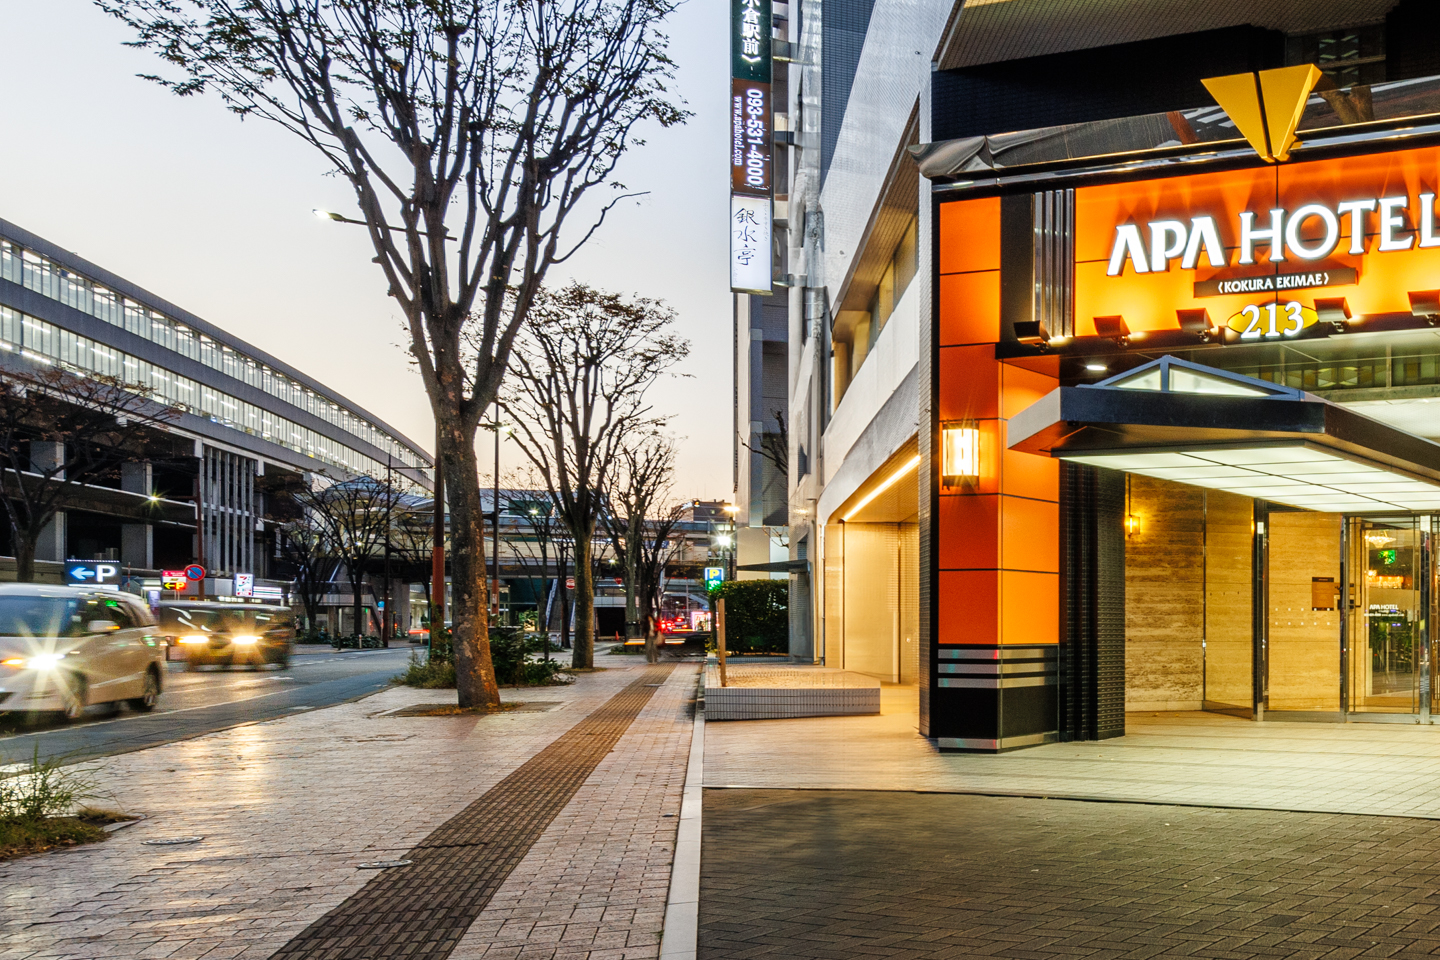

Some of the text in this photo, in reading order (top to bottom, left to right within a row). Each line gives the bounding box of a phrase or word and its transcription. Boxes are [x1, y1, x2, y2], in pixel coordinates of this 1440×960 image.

[734, 96, 744, 166] www.apahotel.com
[747, 89, 764, 186] 093-531-4000
[733, 207, 760, 266] 銀水亭
[1106, 215, 1229, 277] APA
[1240, 300, 1305, 339] 213
[96, 565, 116, 582] P
[175, 581, 185, 590] P
[709, 569, 720, 579] P
